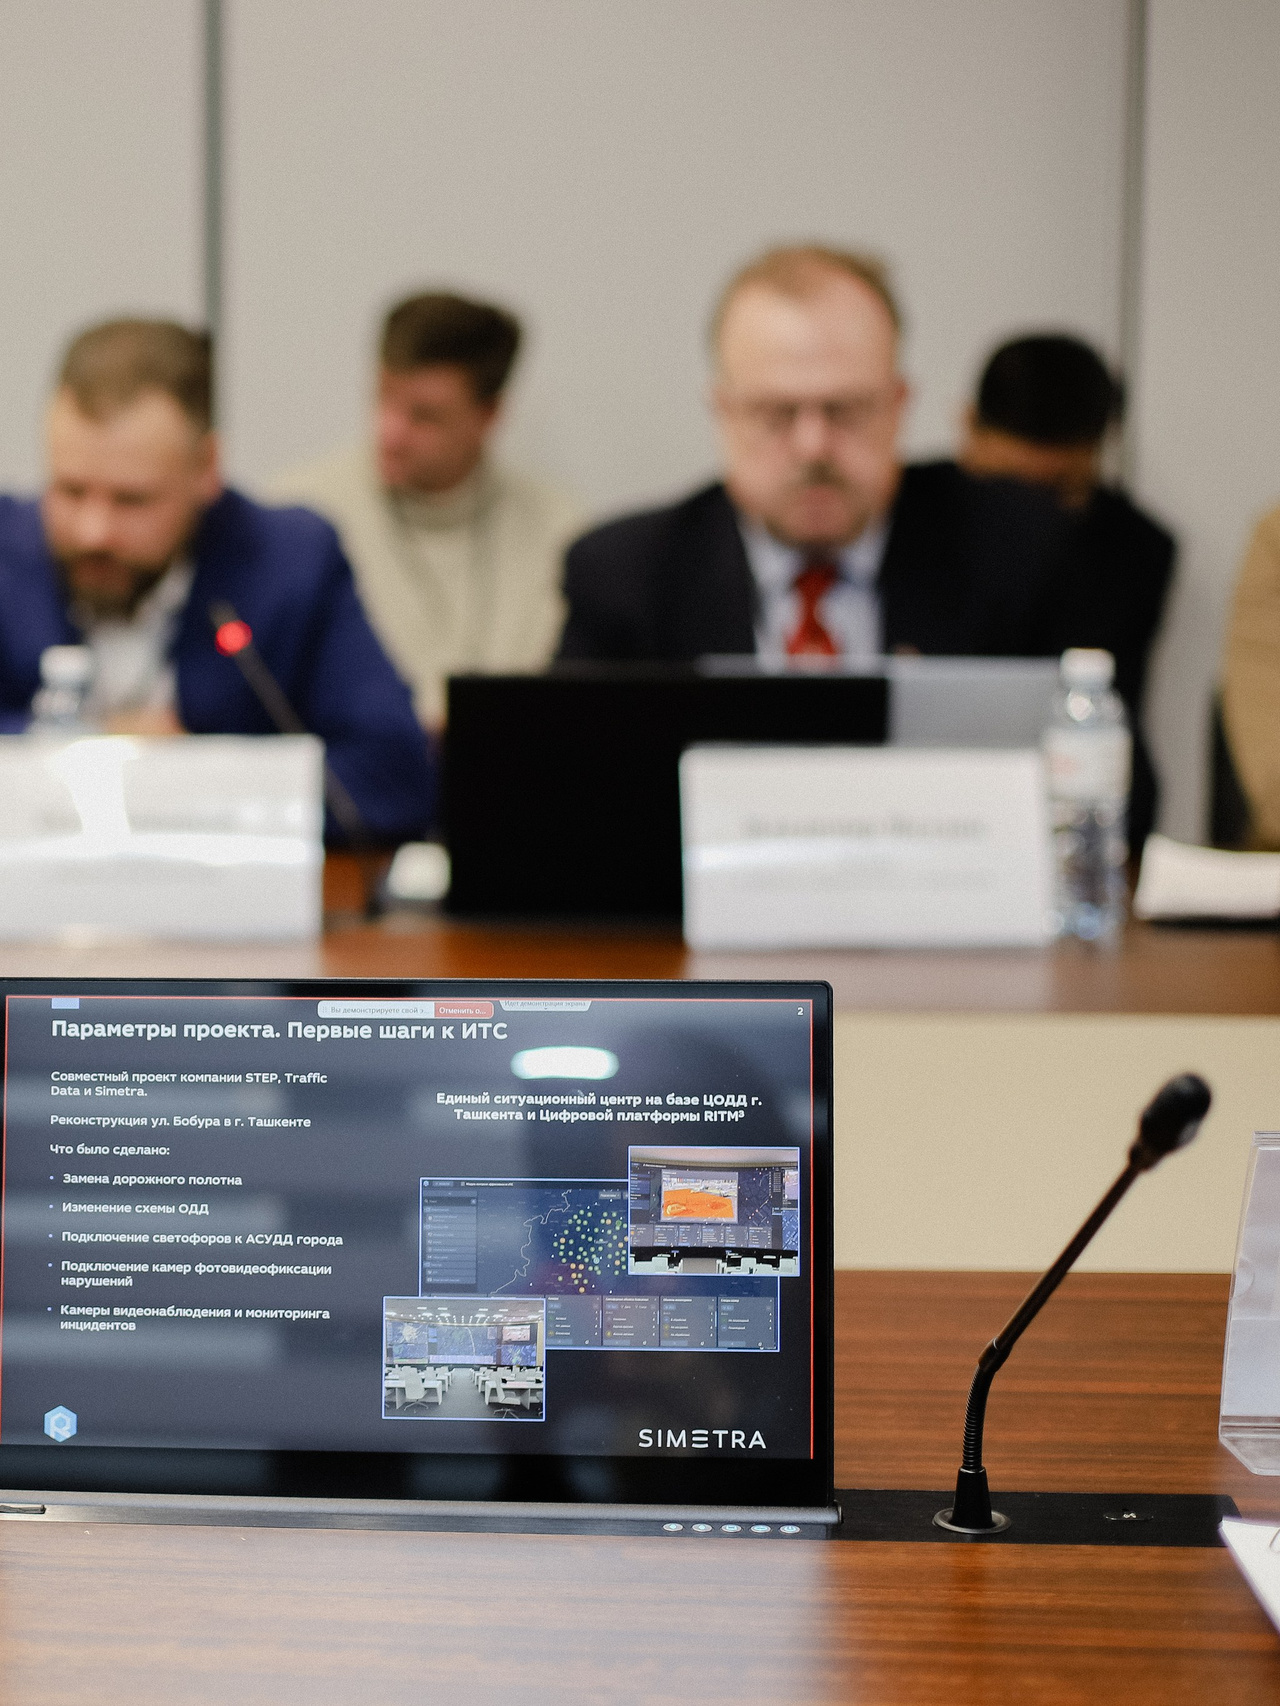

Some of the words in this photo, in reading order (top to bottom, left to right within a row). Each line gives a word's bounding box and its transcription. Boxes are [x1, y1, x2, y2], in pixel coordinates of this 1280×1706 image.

[330, 1006, 341, 1014] Вы
[342, 1006, 400, 1016] демонстрируете
[401, 1006, 418, 1014] свой
[439, 1006, 474, 1014] Отменить
[797, 1007, 804, 1016] 2
[51, 1020, 177, 1040] Параметры
[183, 1024, 281, 1041] проекта.
[287, 1022, 372, 1041] Первые
[379, 1026, 435, 1039] шаги
[441, 1026, 455, 1039] к
[461, 1023, 508, 1039] ИТС
[50, 1071, 129, 1082] Совместный
[131, 1074, 177, 1084] проект
[180, 1074, 242, 1083] компании
[245, 1073, 281, 1084] STEP,
[284, 1072, 328, 1084] Traffic
[50, 1086, 81, 1096] Data
[83, 1088, 92, 1096] и
[94, 1086, 148, 1097] Simetra.
[436, 1092, 490, 1105] Единый
[493, 1093, 596, 1106] ситуационный
[599, 1096, 642, 1108] центр
[645, 1096, 663, 1105] на
[665, 1093, 700, 1106] базе
[702, 1094, 748, 1108] ЦОДД
[750, 1097, 763, 1106] г.
[50, 1115, 148, 1128] Реконструкция
[150, 1118, 170, 1128] ул.
[172, 1115, 221, 1129] Бобура
[223, 1118, 232, 1127] в
[234, 1118, 244, 1127] г.
[247, 1117, 311, 1128] Ташкенте
[453, 1109, 524, 1120] Ташкента
[527, 1112, 536, 1121] и
[539, 1109, 613, 1123] Цифровой
[616, 1110, 700, 1124] платформы
[49, 1144, 74, 1155] Что
[76, 1143, 110, 1155] было
[112, 1147, 170, 1156] сделано:
[62, 1174, 110, 1184] Замена
[111, 1176, 186, 1186] дорожного
[188, 1176, 243, 1186] полотна
[62, 1203, 132, 1213] Изменение
[134, 1205, 176, 1214] схемы
[177, 1204, 210, 1216] ОДД
[61, 1232, 150, 1243] Подключение
[152, 1234, 232, 1246] светофоров
[234, 1236, 243, 1244] к
[245, 1234, 294, 1246] АСУДД
[296, 1236, 344, 1247] города
[61, 1261, 149, 1272] Подключение
[151, 1264, 192, 1275] камер
[194, 1264, 332, 1276] фотовидеофиксации
[60, 1276, 133, 1288] нарушений
[60, 1305, 111, 1318] Камеры
[112, 1306, 232, 1318] видеонаблюдения
[233, 1309, 243, 1318] и
[245, 1310, 331, 1321] мониторинга
[59, 1322, 137, 1332] инцидентов
[638, 1428, 767, 1450] SIMETRA
